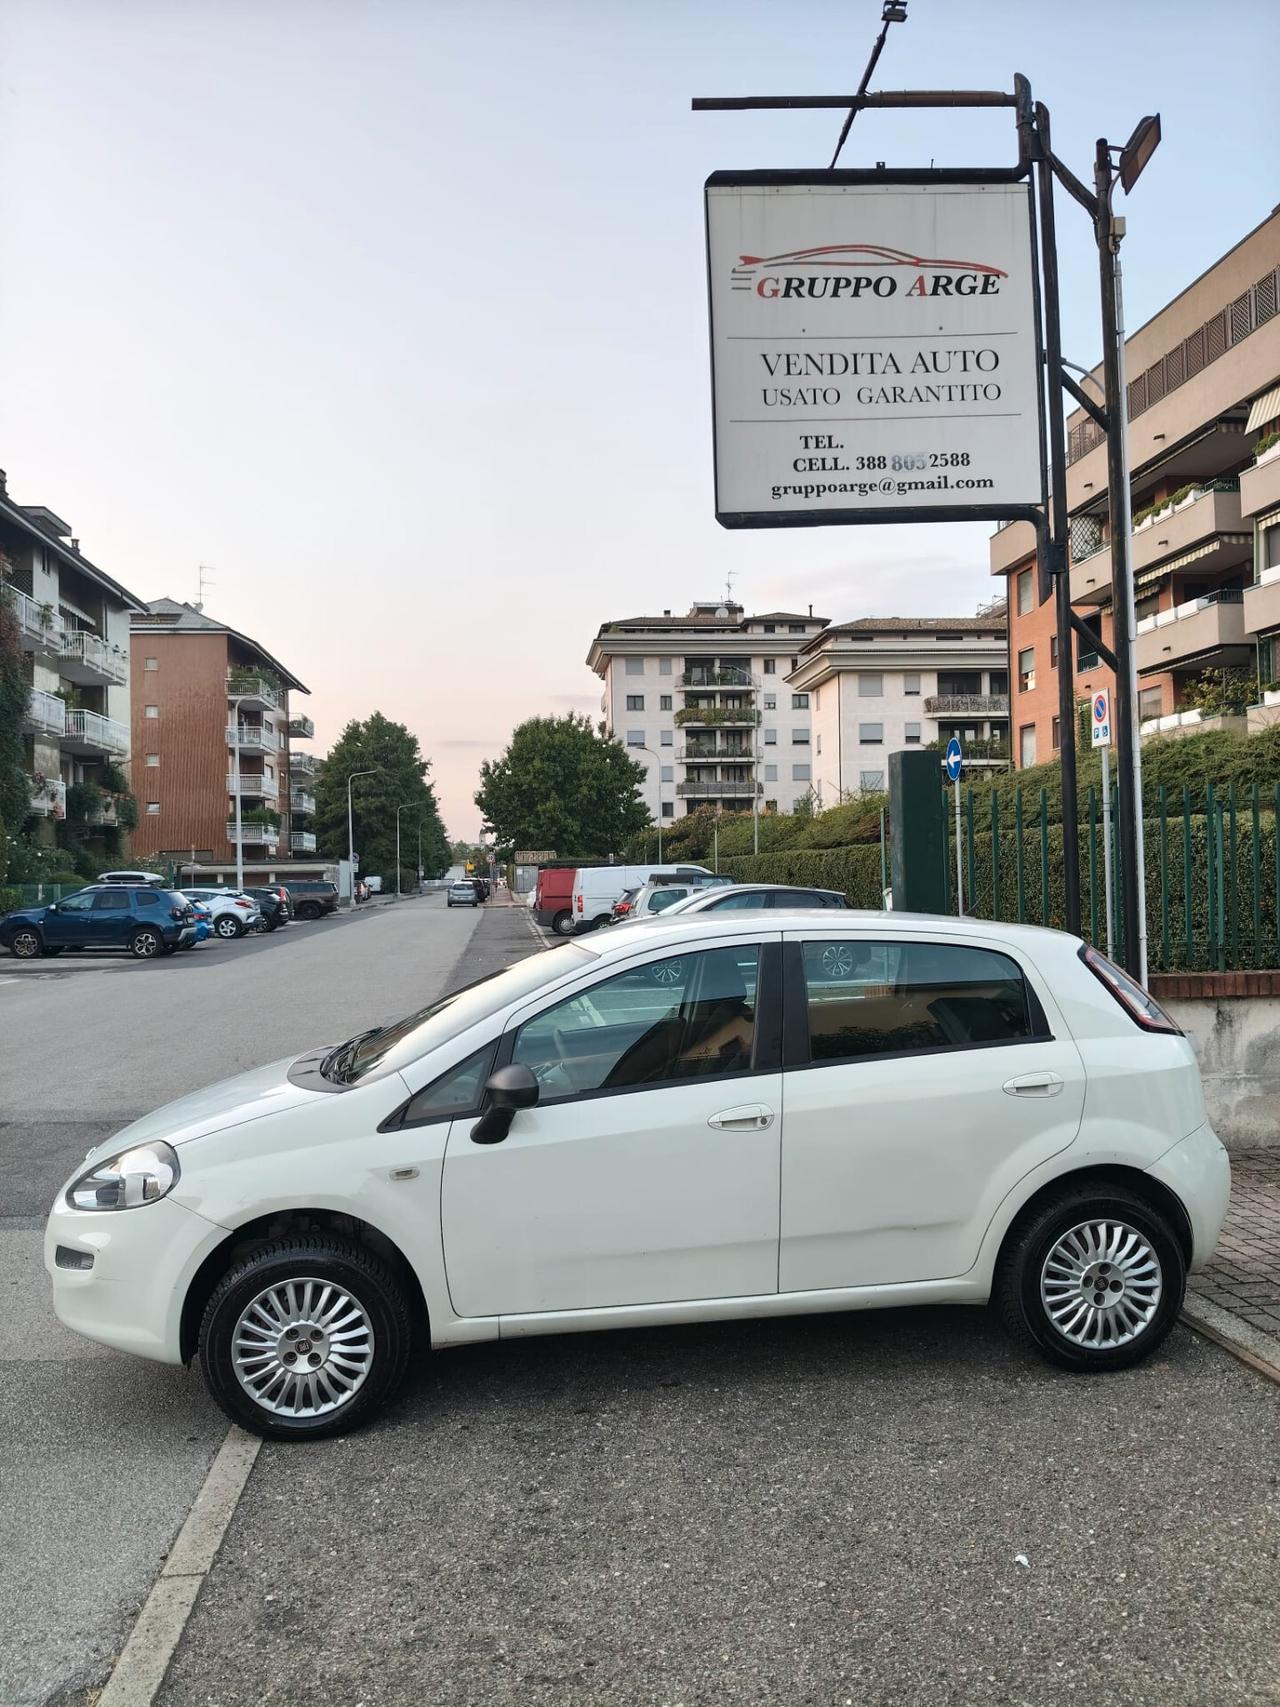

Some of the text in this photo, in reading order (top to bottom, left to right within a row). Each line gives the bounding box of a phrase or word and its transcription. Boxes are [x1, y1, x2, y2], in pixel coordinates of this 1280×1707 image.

[756, 273, 1001, 299] GRUPPO ARGE
[760, 349, 1000, 376] VENDITA AUTO
[762, 383, 1002, 407] USATO GARANTITO
[799, 434, 845, 450] TEL.
[792, 456, 850, 473] CELL.
[855, 455, 888, 471] 388
[928, 452, 971, 468] 2588
[771, 474, 994, 500] gruppoarge@gmail.com
